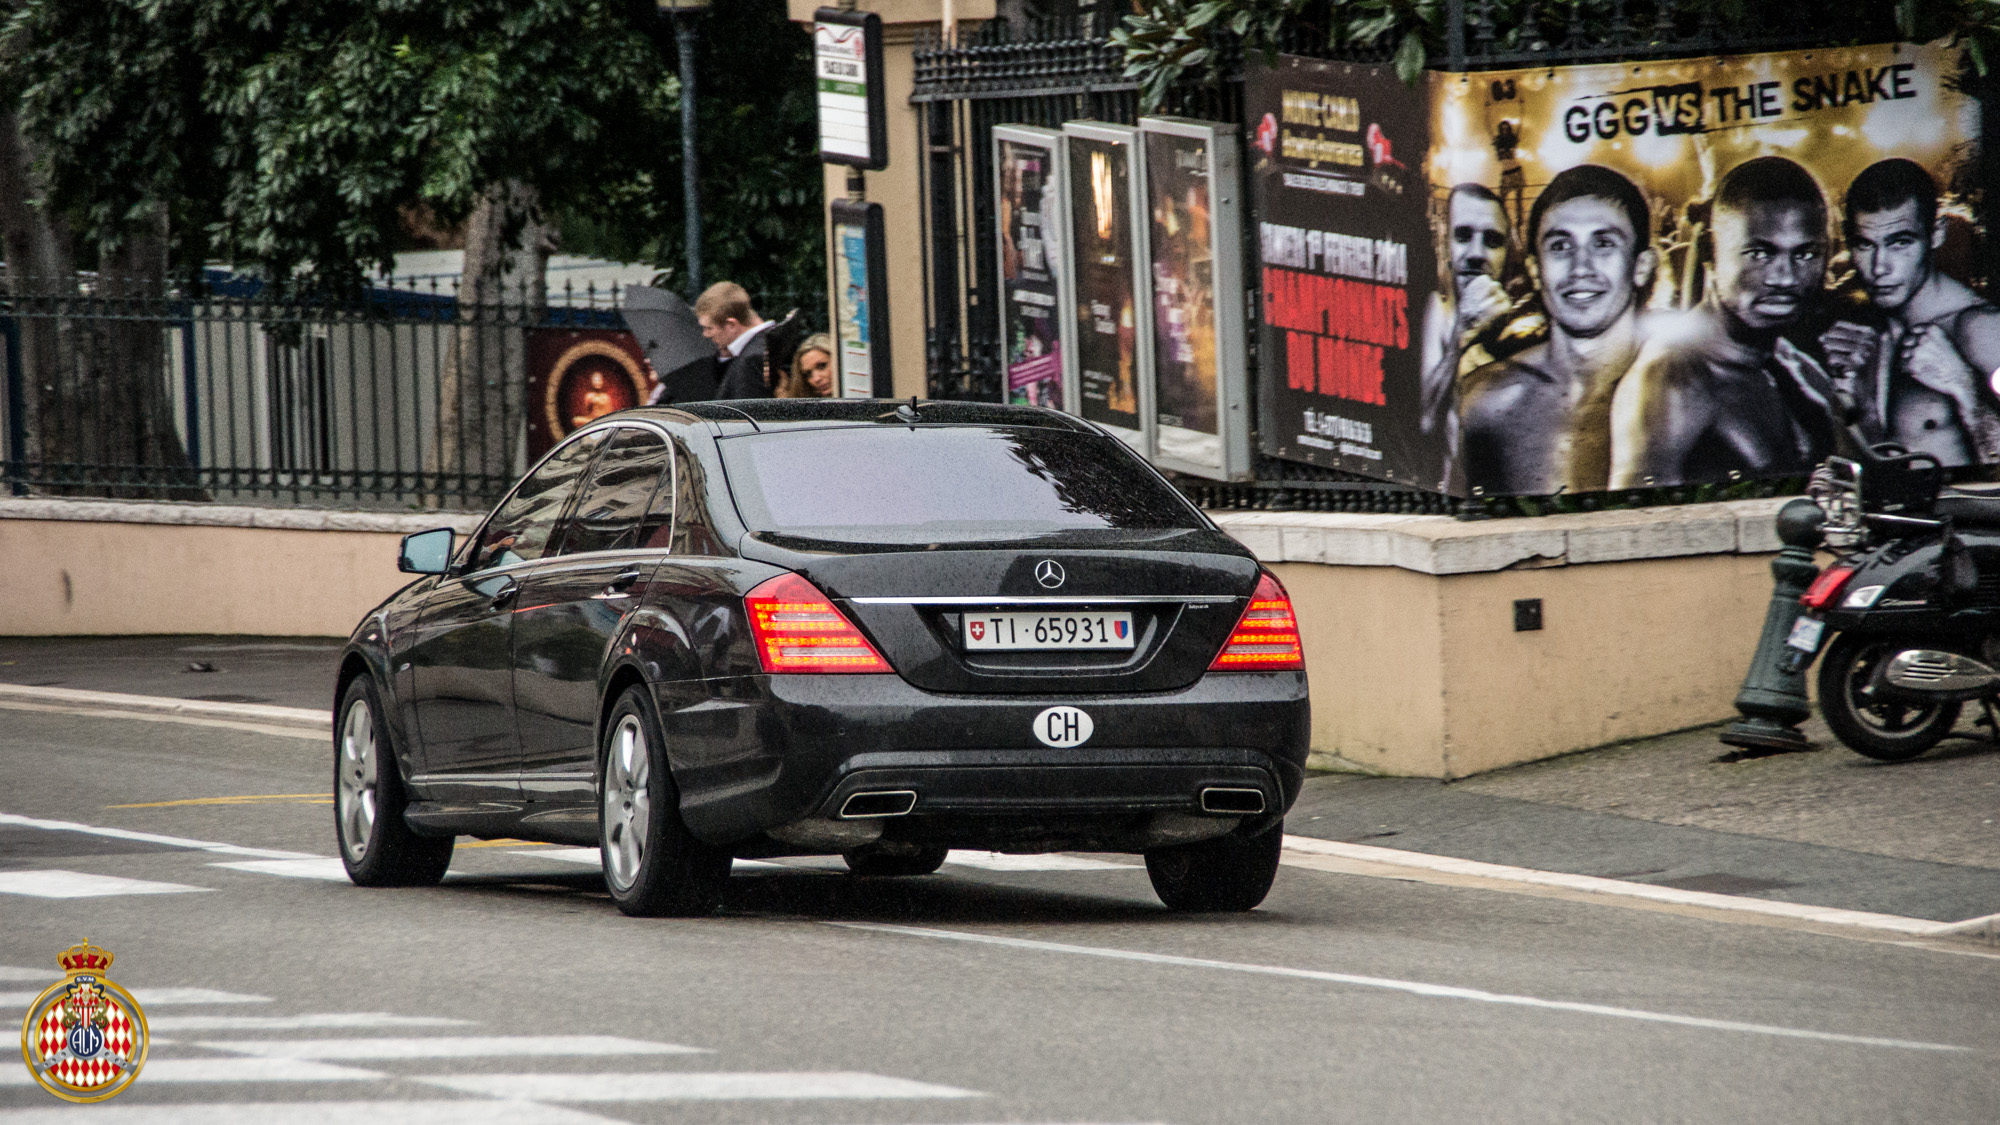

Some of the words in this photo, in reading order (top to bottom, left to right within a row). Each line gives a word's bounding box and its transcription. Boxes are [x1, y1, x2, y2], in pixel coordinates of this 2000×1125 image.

[1565, 98, 1650, 143] GGG
[1655, 92, 1699, 128] VS
[1710, 81, 1783, 122] THE
[1791, 63, 1917, 112] SNAKE
[1047, 712, 1080, 742] CH
